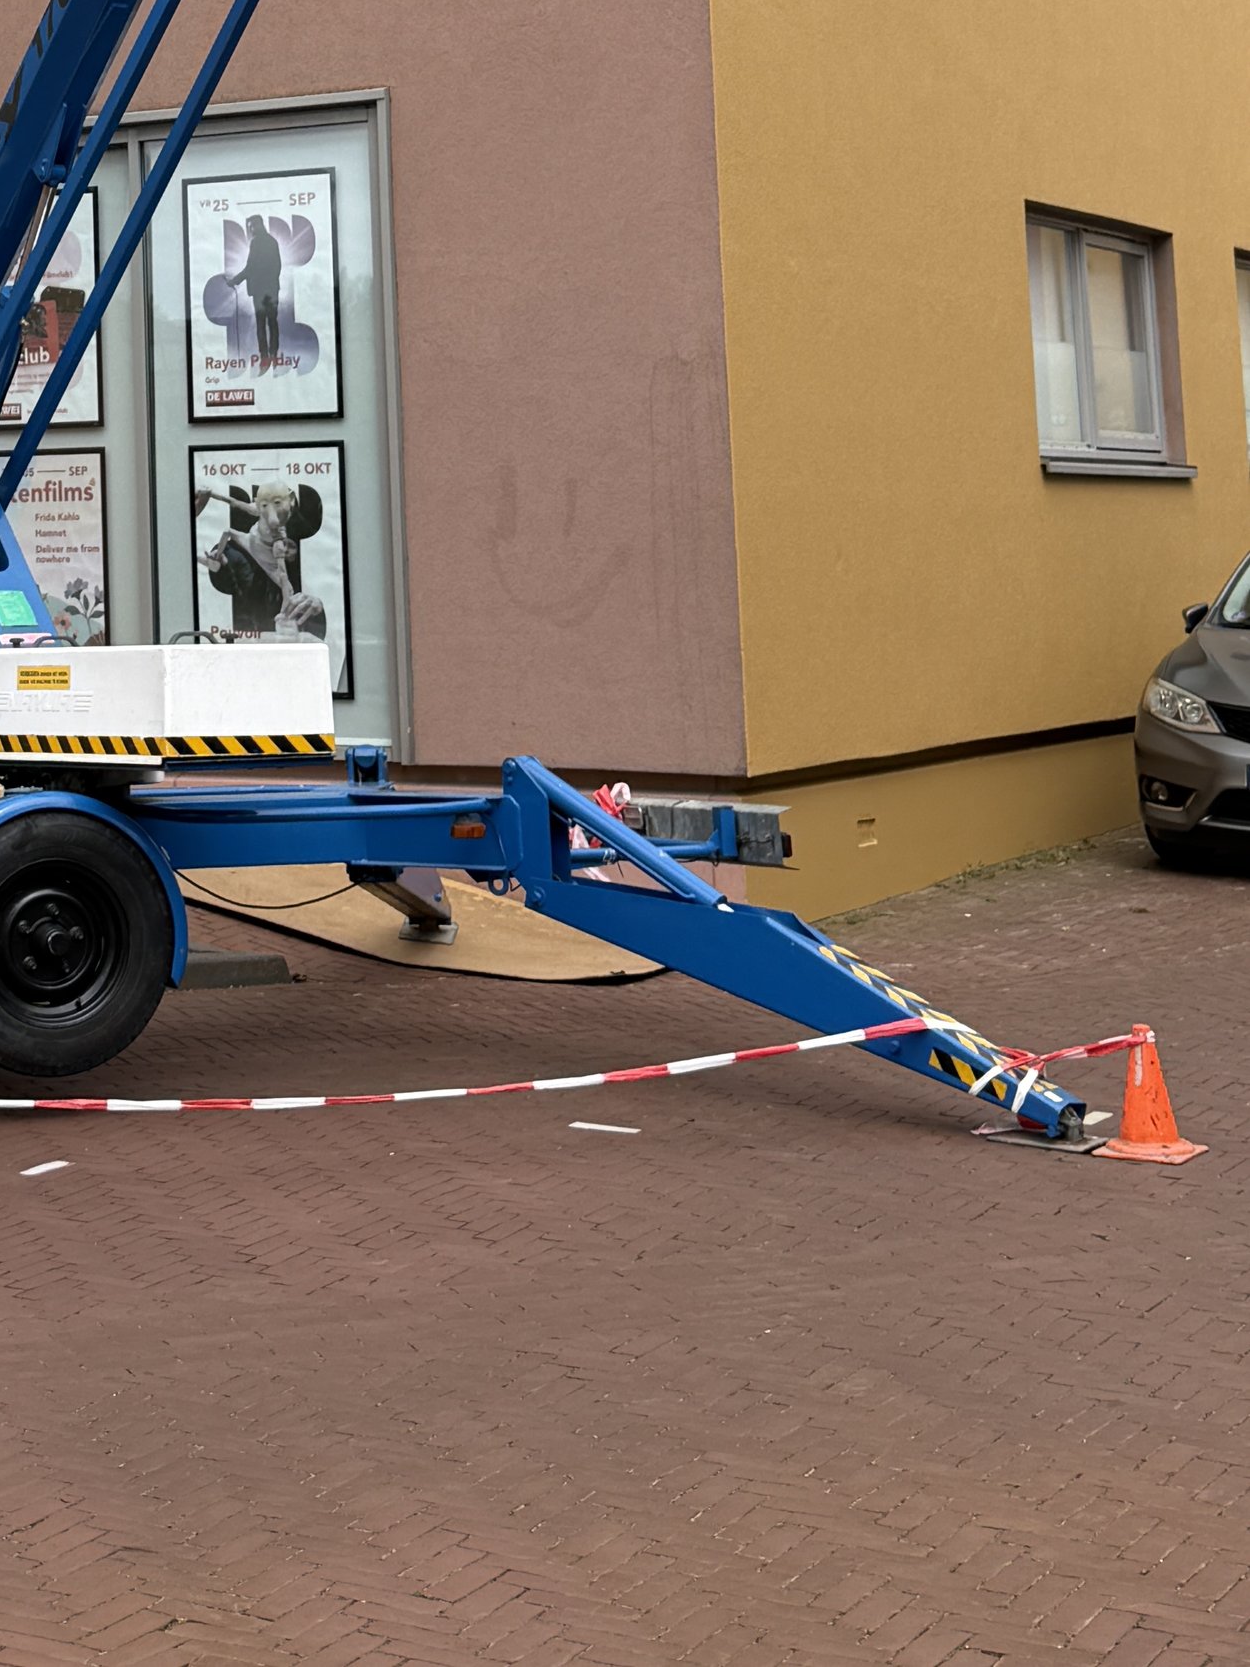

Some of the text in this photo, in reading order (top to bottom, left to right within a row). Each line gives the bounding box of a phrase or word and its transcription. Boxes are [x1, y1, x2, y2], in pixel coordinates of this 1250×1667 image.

[213, 199, 229, 212] 25
[289, 192, 316, 206] SEP
[205, 356, 246, 373] Rayen
[207, 390, 253, 402] DE LAWEI
[69, 466, 88, 476] SEP
[203, 462, 331, 475] 16 OKT 18 OKT
[12, 480, 94, 503] enfilms
[35, 513, 56, 521] Frida
[81, 544, 100, 553] from
